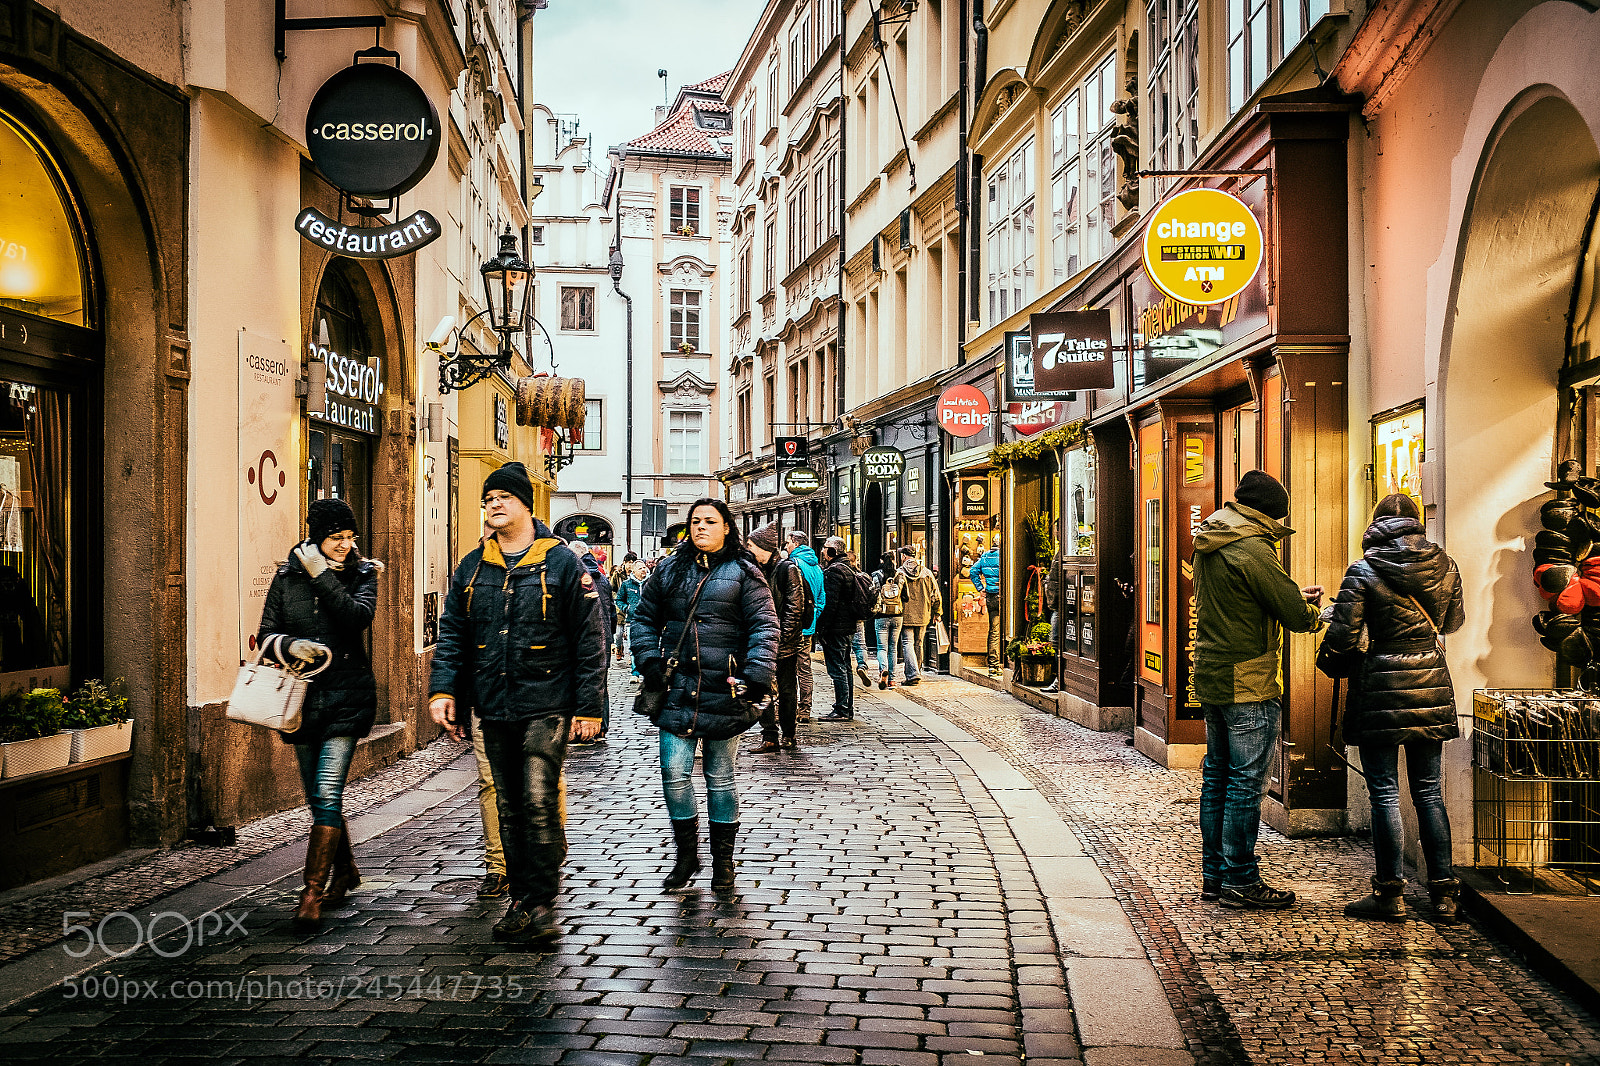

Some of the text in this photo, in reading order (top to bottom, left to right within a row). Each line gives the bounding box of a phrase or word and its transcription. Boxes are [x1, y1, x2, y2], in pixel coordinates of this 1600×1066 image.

[299, 212, 432, 253] restaurant
[1156, 218, 1246, 242] change
[1162, 246, 1210, 254] WESTERN
[1177, 252, 1210, 260] UNION
[1183, 266, 1225, 281] ATM
[1037, 332, 1066, 370] 7
[1064, 337, 1108, 352] Tales
[1057, 351, 1105, 364] Suites
[942, 408, 990, 426] Praha
[864, 452, 903, 465] KOSTA
[1185, 438, 1204, 479] WU
[867, 464, 901, 476] BODA
